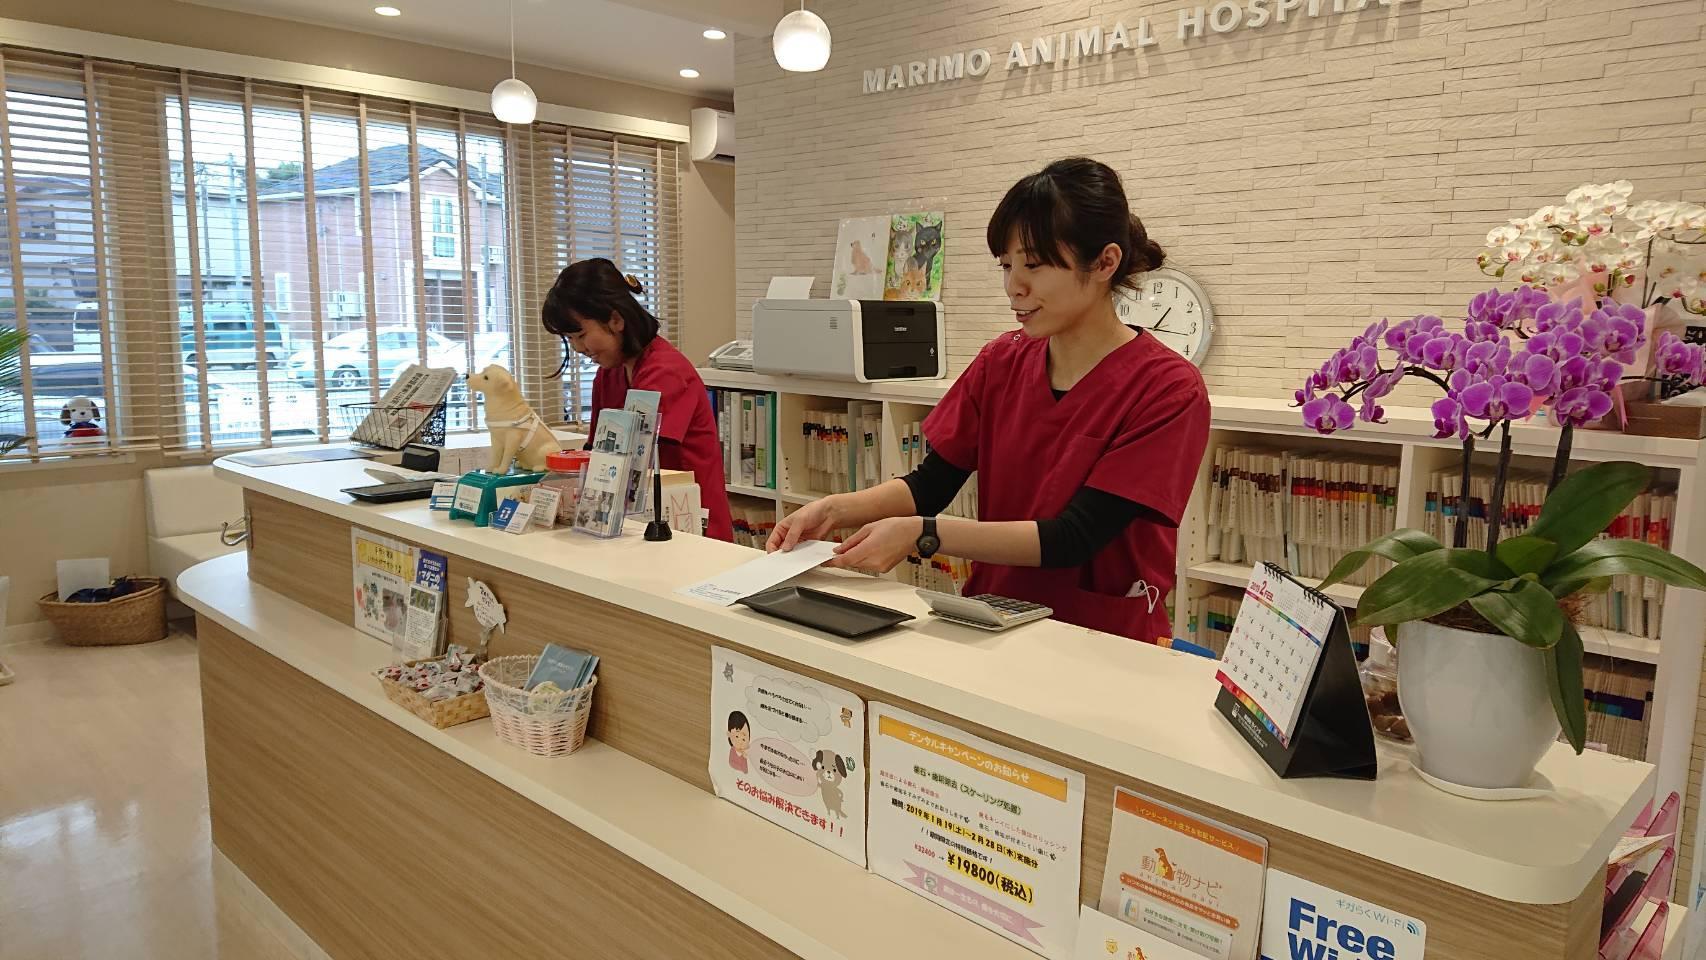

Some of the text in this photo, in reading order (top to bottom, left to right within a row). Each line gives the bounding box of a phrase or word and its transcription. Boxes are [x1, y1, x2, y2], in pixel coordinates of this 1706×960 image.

[863, 48, 992, 95] MARIMO
[1005, 14, 1159, 71] ANIMAL
[1260, 580, 1268, 596] 2
[908, 730, 1031, 783] デンタルキャンペーンのお知らせ
[1141, 855, 1223, 900] 動物ナビ
[1289, 897, 1395, 960] Free
